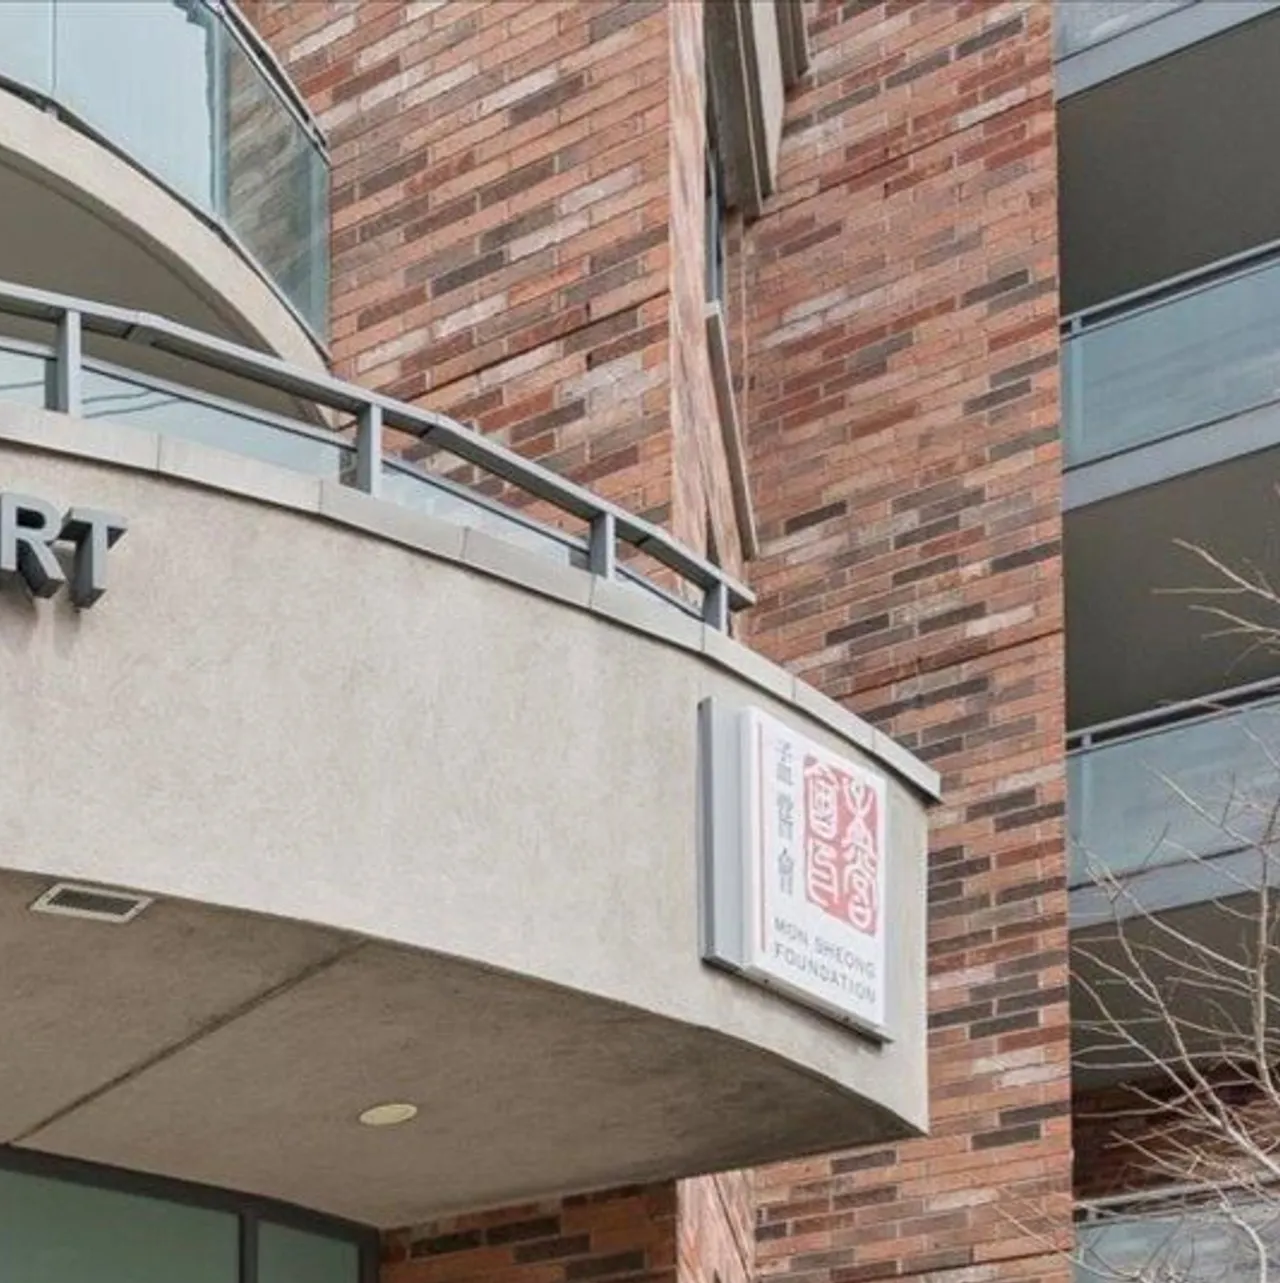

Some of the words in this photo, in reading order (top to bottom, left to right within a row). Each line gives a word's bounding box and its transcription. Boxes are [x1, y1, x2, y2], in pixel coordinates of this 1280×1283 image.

[774, 917, 809, 947] MON
[814, 935, 877, 980] SHEONG
[774, 940, 877, 1004] FOUNDATION
